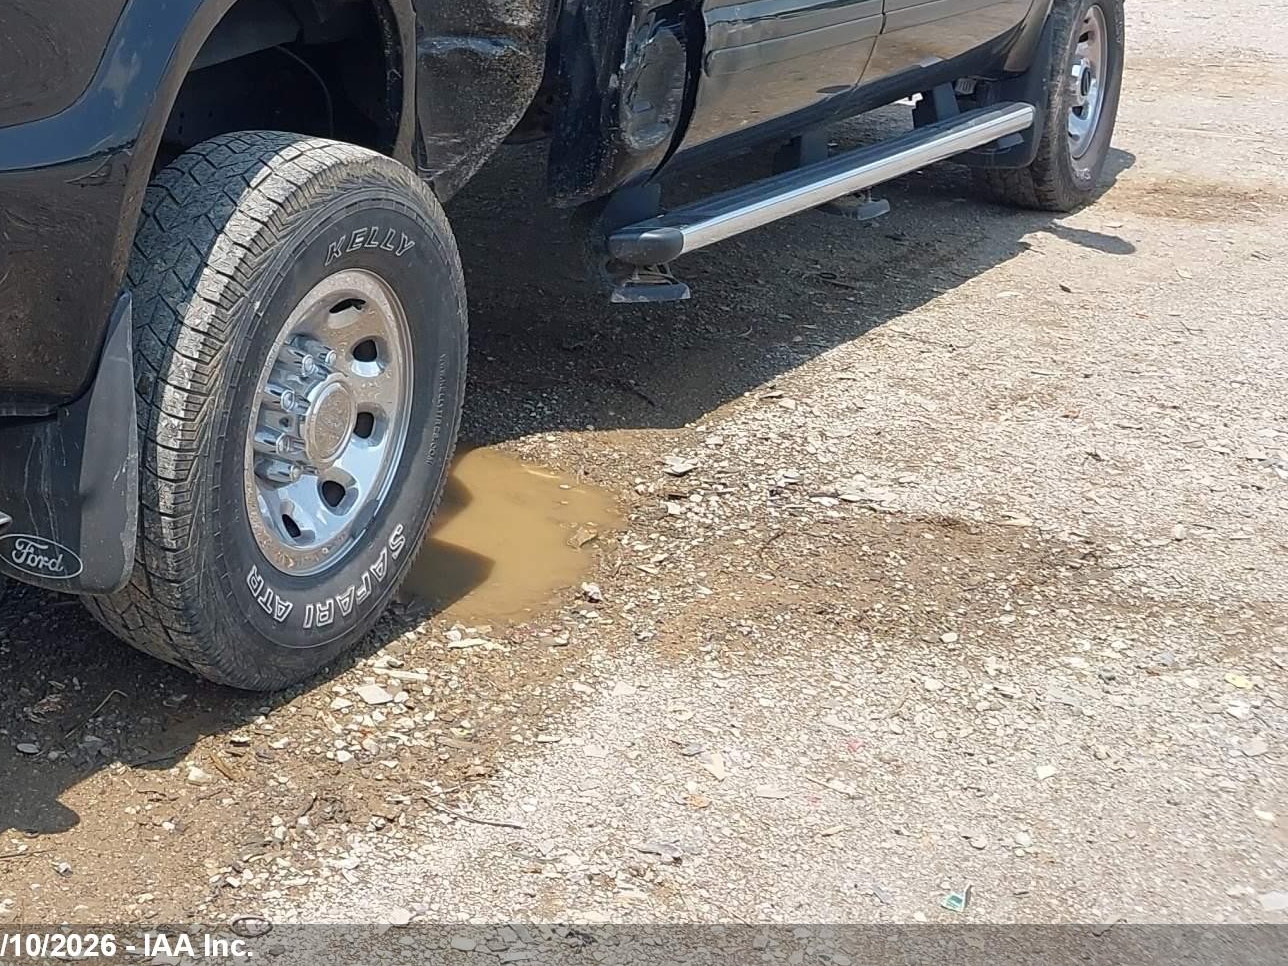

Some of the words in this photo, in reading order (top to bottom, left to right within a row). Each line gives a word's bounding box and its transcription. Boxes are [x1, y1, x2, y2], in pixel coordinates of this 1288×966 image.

[324, 226, 416, 266] KELLY
[12, 537, 64, 572] Ford
[303, 523, 406, 629] SAFARI
[246, 564, 294, 623] ATR
